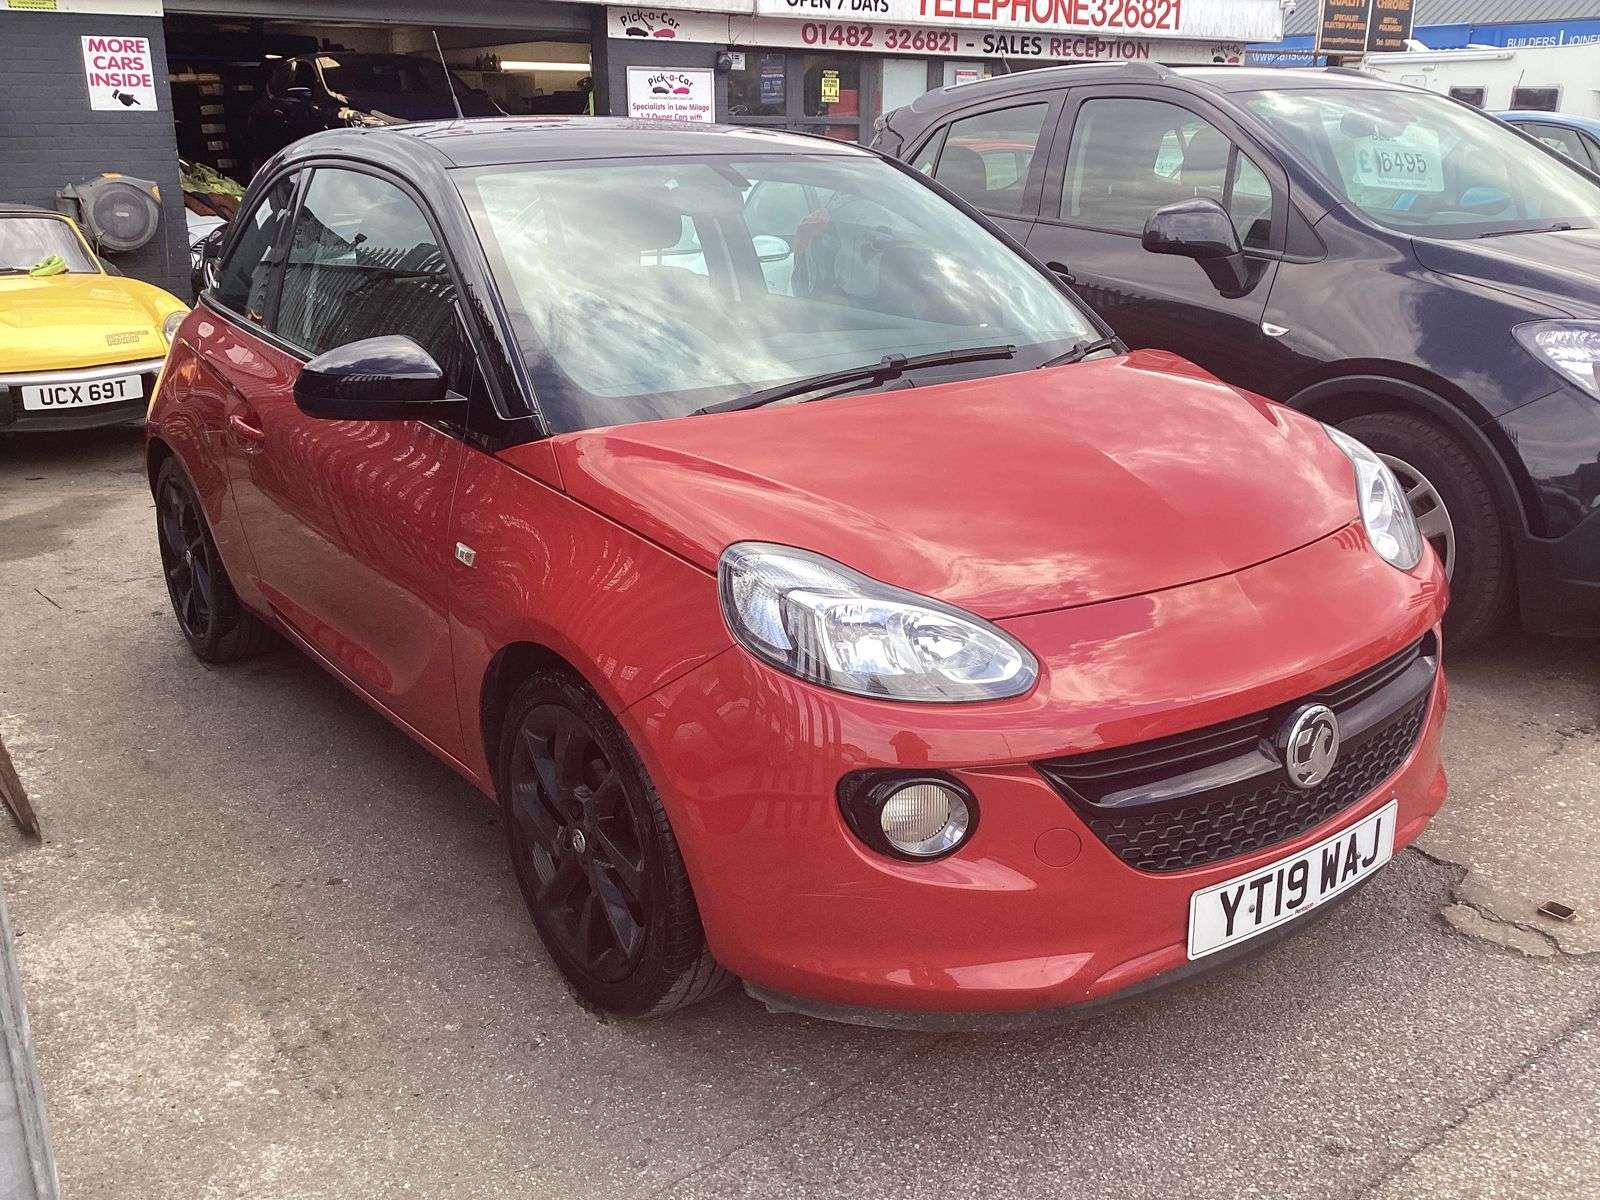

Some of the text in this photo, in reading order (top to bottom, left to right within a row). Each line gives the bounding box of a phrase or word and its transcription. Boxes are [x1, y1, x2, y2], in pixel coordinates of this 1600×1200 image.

[851, 0, 889, 13] DAYS
[620, 9, 680, 30] Pick-a-Car
[88, 38, 146, 53] MORE
[801, 22, 874, 47] 01482
[884, 28, 959, 52] 326821
[983, 33, 1042, 56] SALES
[1049, 37, 1150, 60] RECEPTION
[1507, 36, 1557, 48] BUILDERS
[93, 55, 145, 71] CARS
[89, 73, 152, 87] INSIDE
[648, 73, 694, 88] Pick-a-Car
[632, 102, 666, 111] Specialists
[39, 379, 127, 406] UCX 69T
[1219, 818, 1383, 938] YT19 WAJ
